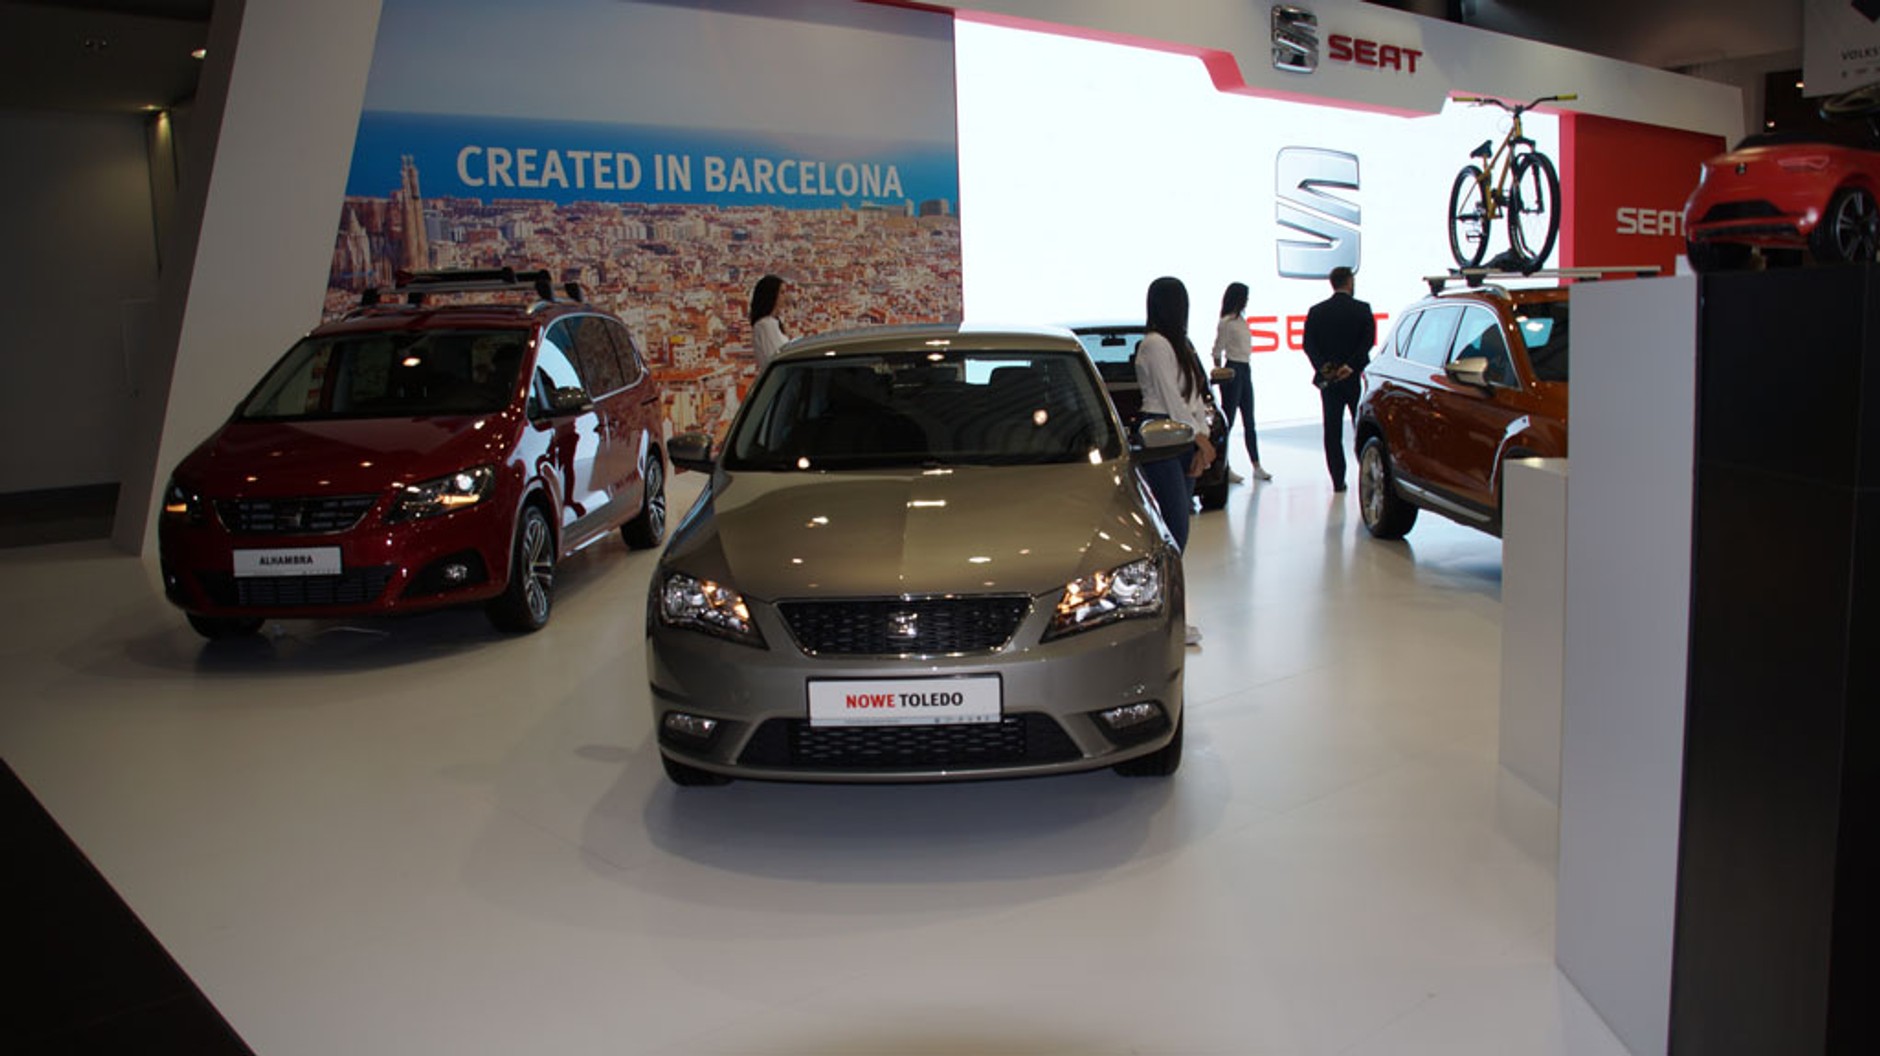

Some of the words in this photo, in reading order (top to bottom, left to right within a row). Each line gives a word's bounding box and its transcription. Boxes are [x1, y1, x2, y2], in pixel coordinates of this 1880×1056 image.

[1328, 34, 1423, 73] SEAT
[1841, 46, 1880, 60] VOLKS
[456, 145, 642, 190] CREATED
[654, 154, 692, 191] IN
[704, 156, 904, 198] BARCELONA
[1246, 313, 1389, 353] SET
[259, 555, 313, 565] ALHAMBRA
[846, 694, 895, 708] NOWE
[899, 692, 963, 707] TOLEDO
